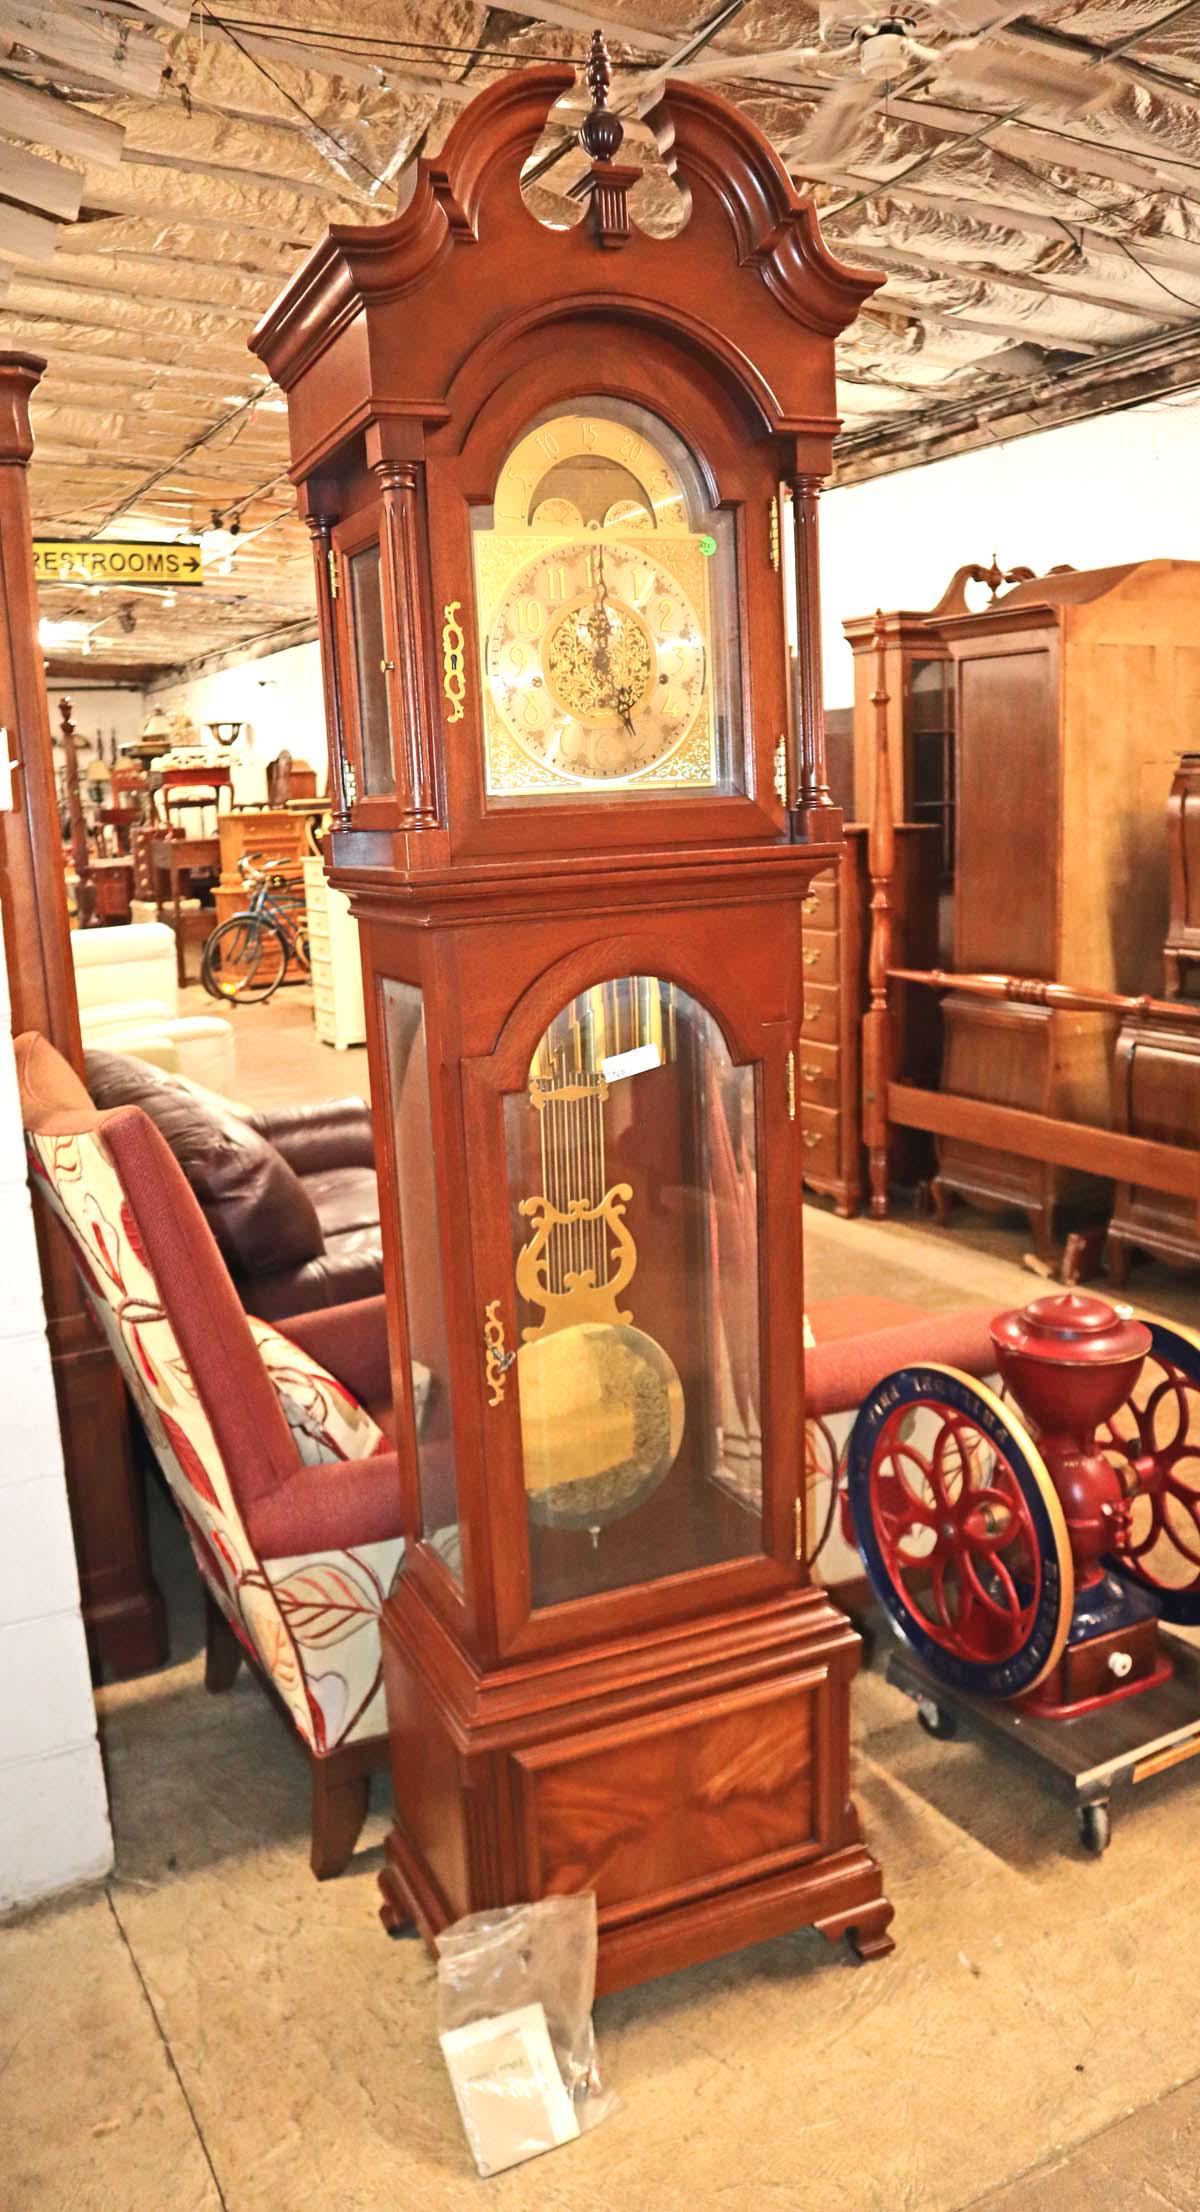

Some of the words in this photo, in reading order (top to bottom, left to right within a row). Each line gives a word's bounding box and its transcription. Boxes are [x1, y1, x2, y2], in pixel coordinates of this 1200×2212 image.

[534, 430, 560, 459] 10
[33, 551, 180, 573] RESTROOMS
[547, 567, 567, 600] 11
[515, 600, 542, 634] 10
[659, 599, 674, 633] 2
[671, 645, 688, 673] 3
[523, 691, 542, 725] 8
[662, 687, 681, 718] 4
